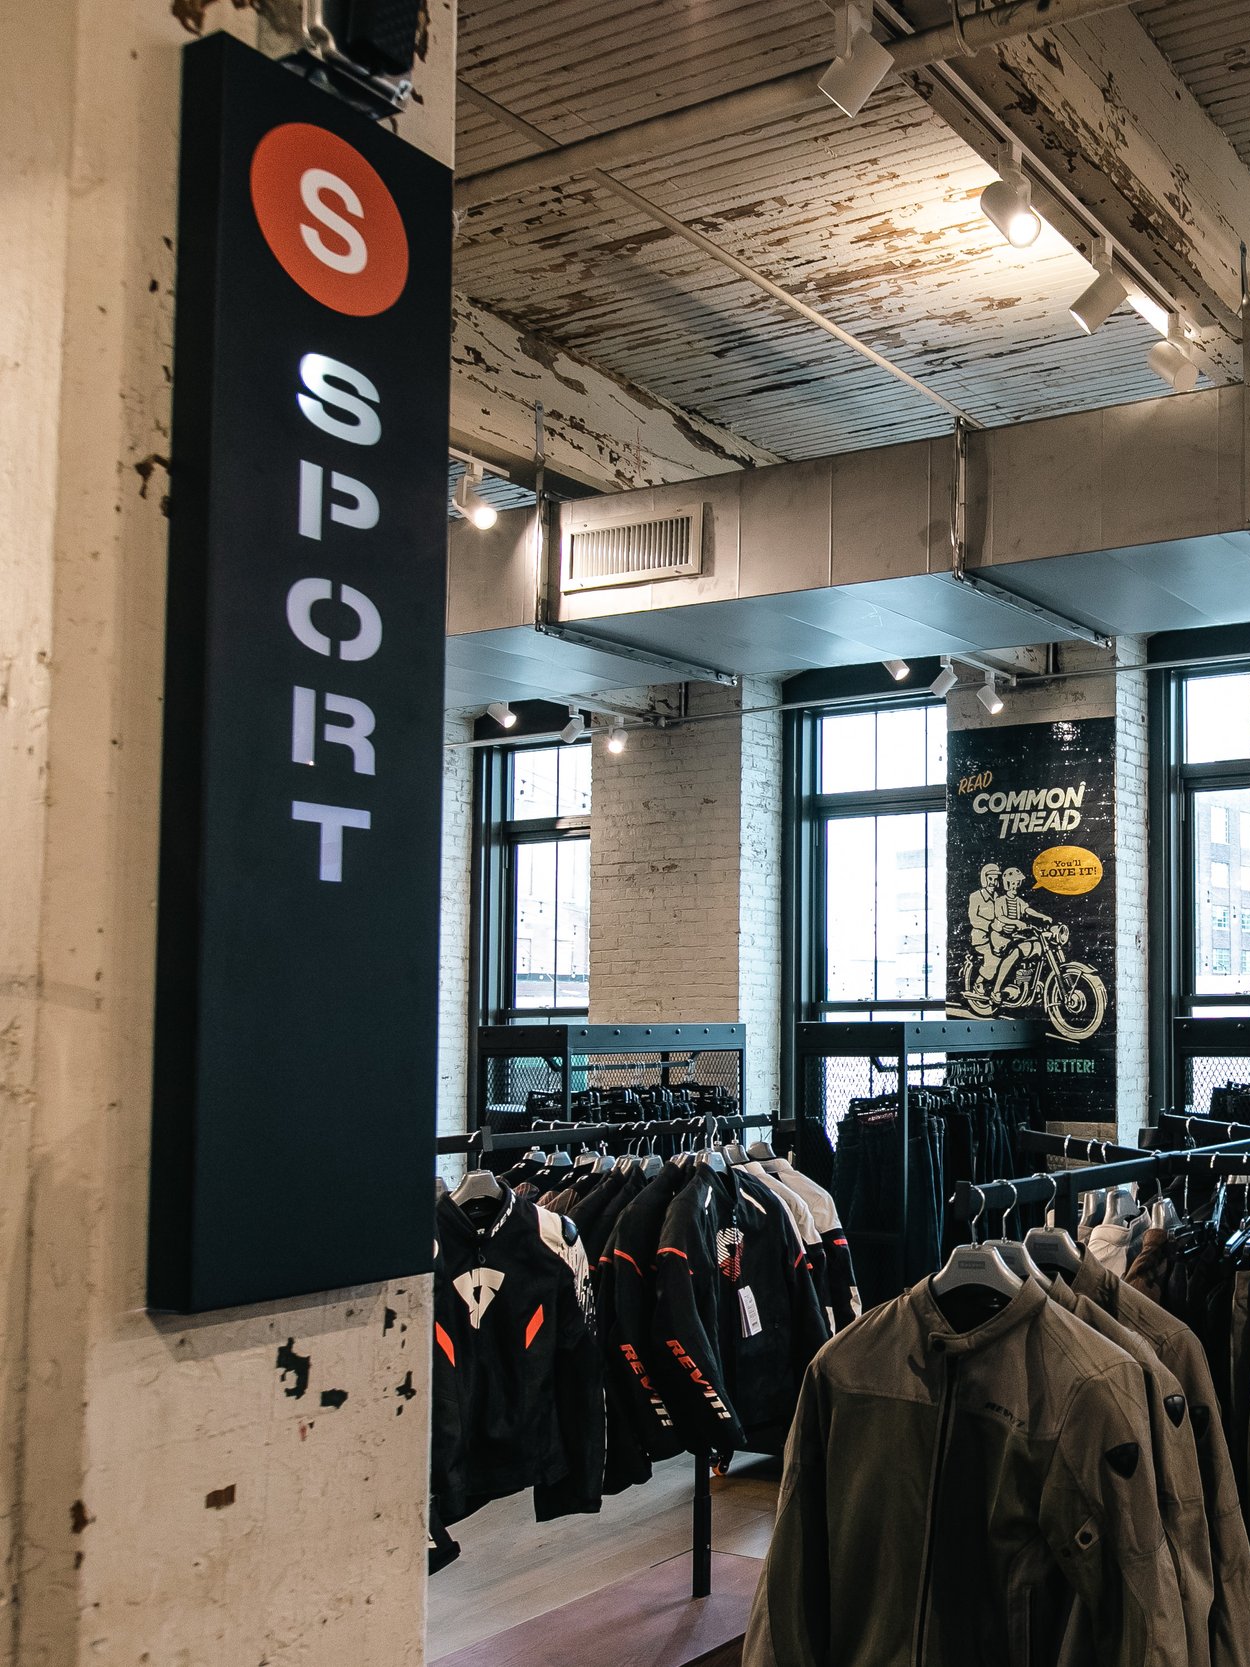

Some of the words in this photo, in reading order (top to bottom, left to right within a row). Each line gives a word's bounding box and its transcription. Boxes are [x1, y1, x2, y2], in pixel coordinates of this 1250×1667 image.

[300, 168, 368, 275] S
[286, 352, 383, 882] SPORT
[958, 770, 993, 795] READ
[973, 784, 1085, 814] COMMON
[999, 809, 1081, 839] TREAD
[1041, 867, 1076, 877] LOVE
[1079, 866, 1097, 876] IT!
[1047, 1058, 1095, 1073] BETTER!
